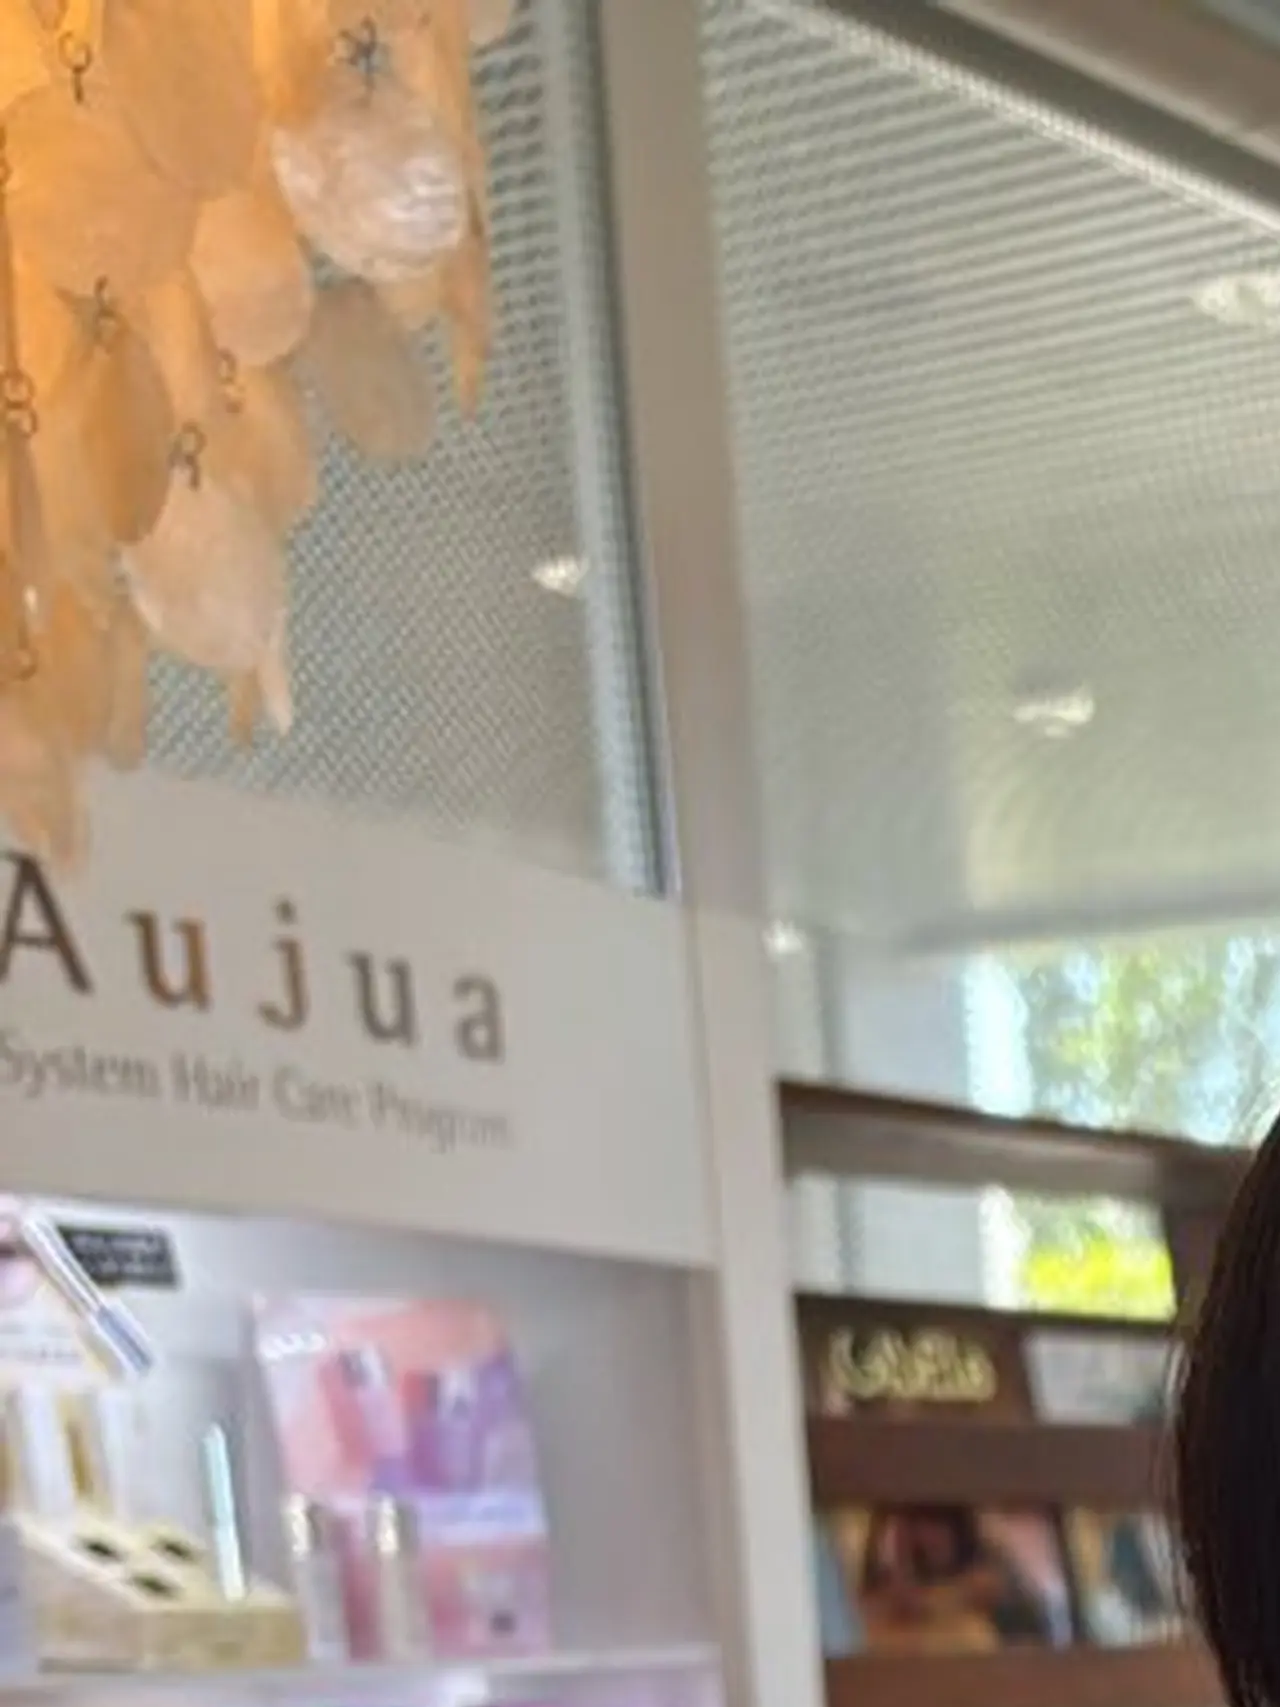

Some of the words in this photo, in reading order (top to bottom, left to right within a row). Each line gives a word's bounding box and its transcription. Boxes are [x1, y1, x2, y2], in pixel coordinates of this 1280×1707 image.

[0, 848, 507, 1064] Aujua
[0, 1030, 160, 1098] System
[170, 1050, 261, 1112] Hair
[272, 1064, 362, 1130] Care
